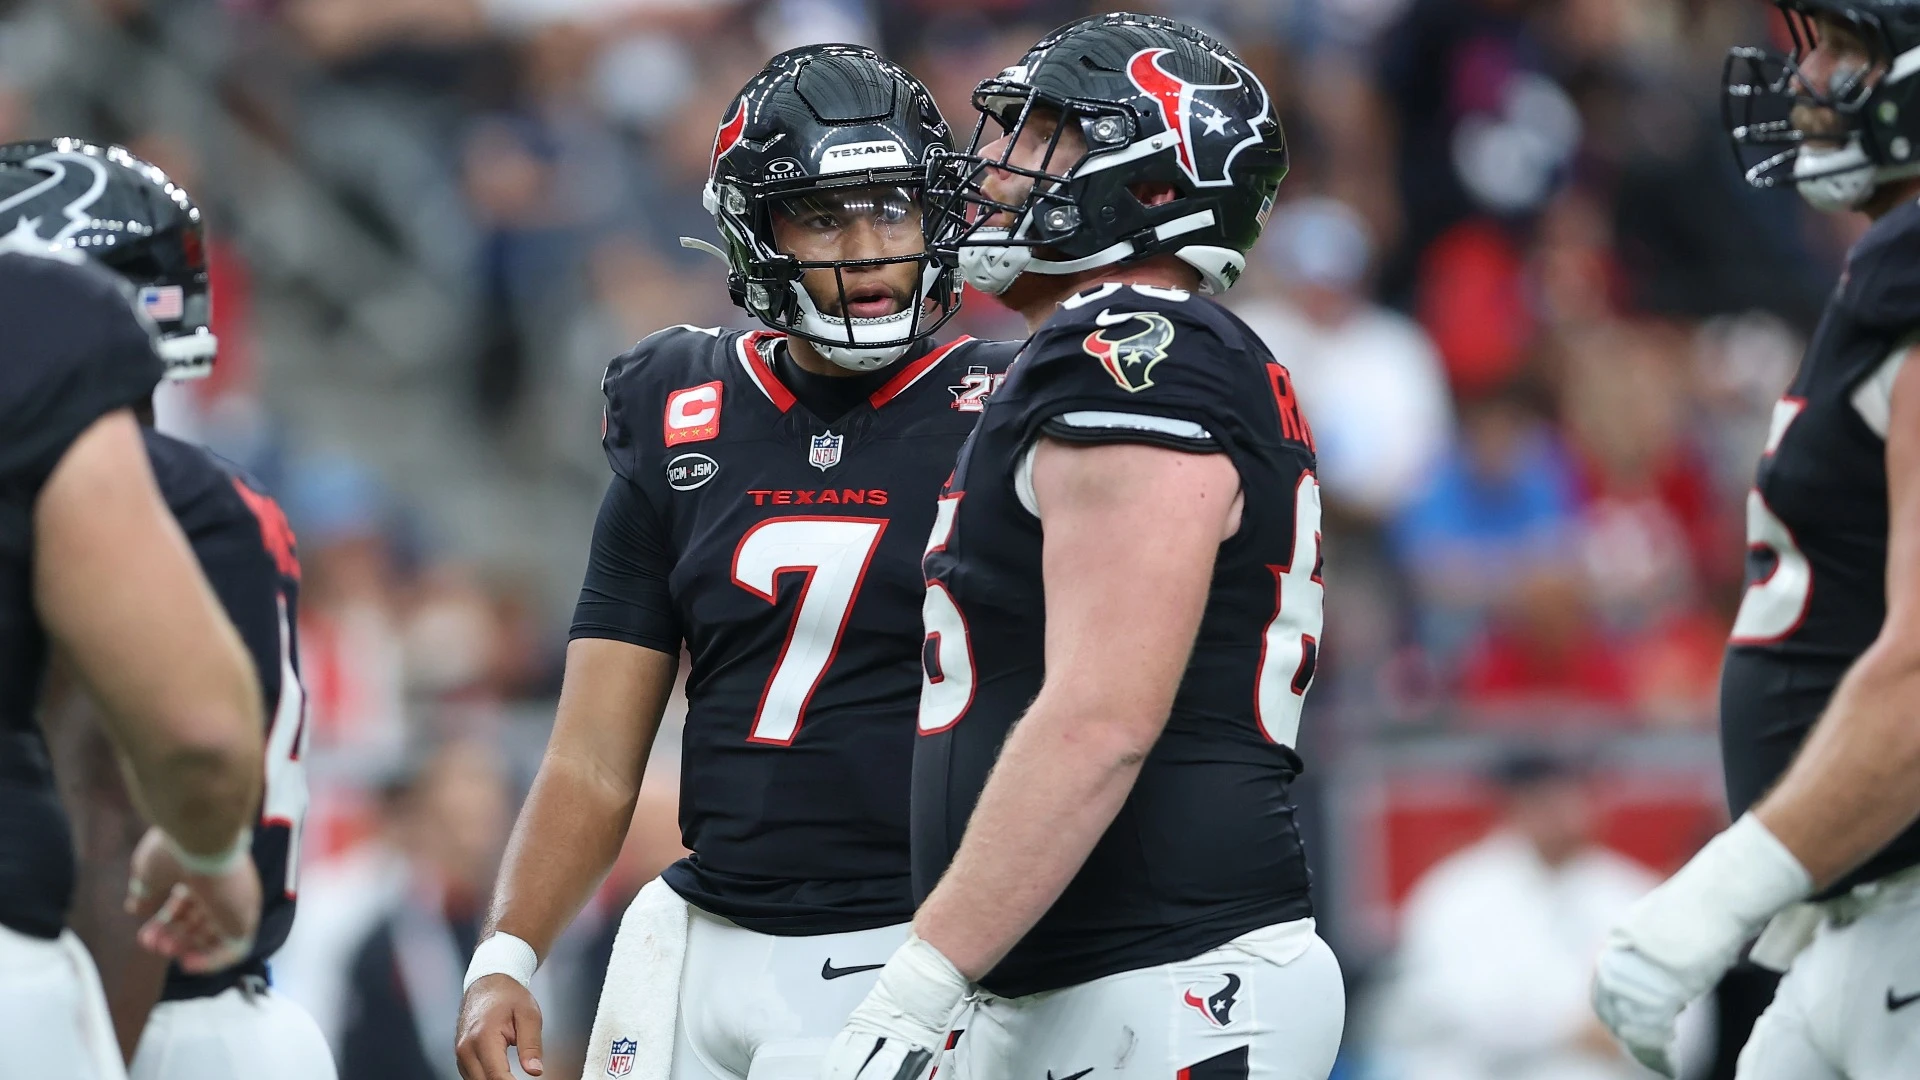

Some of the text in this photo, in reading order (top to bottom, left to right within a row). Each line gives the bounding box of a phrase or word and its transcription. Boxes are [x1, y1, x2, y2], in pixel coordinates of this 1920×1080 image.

[829, 145, 897, 158] TEXANS
[765, 170, 802, 181] OAKLEY
[669, 386, 717, 429] C
[815, 448, 835, 464] NFL
[691, 462, 712, 477] JSM
[746, 489, 888, 506] TEXANS
[730, 514, 890, 747] 7
[609, 1055, 631, 1074] NFL
